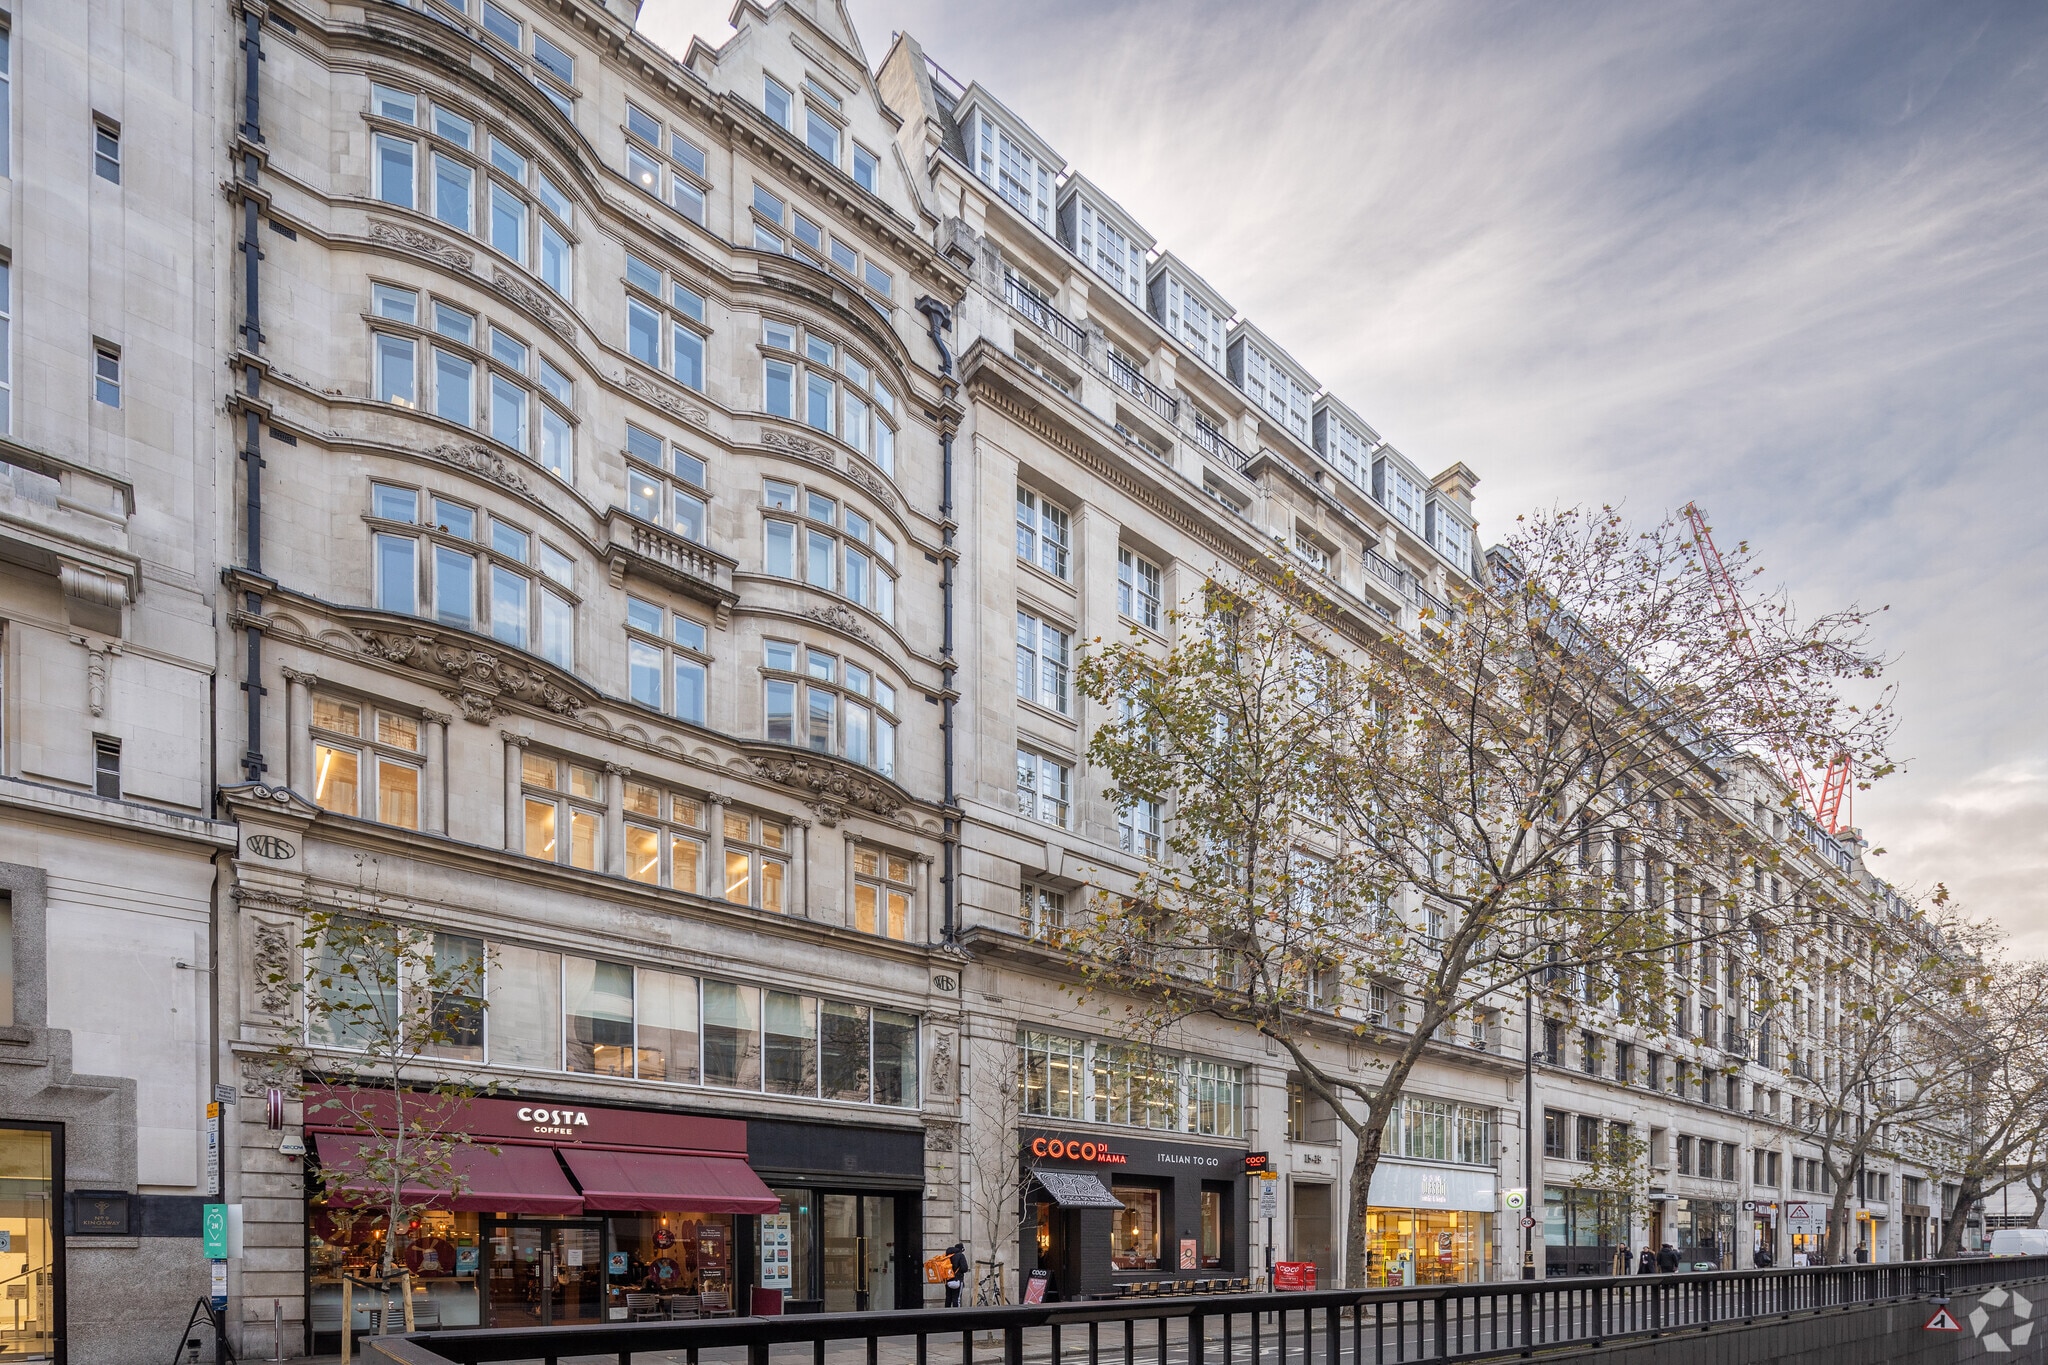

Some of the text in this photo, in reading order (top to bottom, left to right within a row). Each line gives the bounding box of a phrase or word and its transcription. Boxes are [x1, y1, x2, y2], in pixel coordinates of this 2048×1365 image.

[517, 1107, 589, 1126] COSTA
[533, 1126, 573, 1135] COFFEE
[1032, 1137, 1108, 1161] COCO DI
[1097, 1153, 1127, 1164] MAMA
[1157, 1153, 1219, 1166] ITALIAN TO GO
[1245, 1156, 1266, 1165] COCO
[1280, 1265, 1300, 1273] COCO
